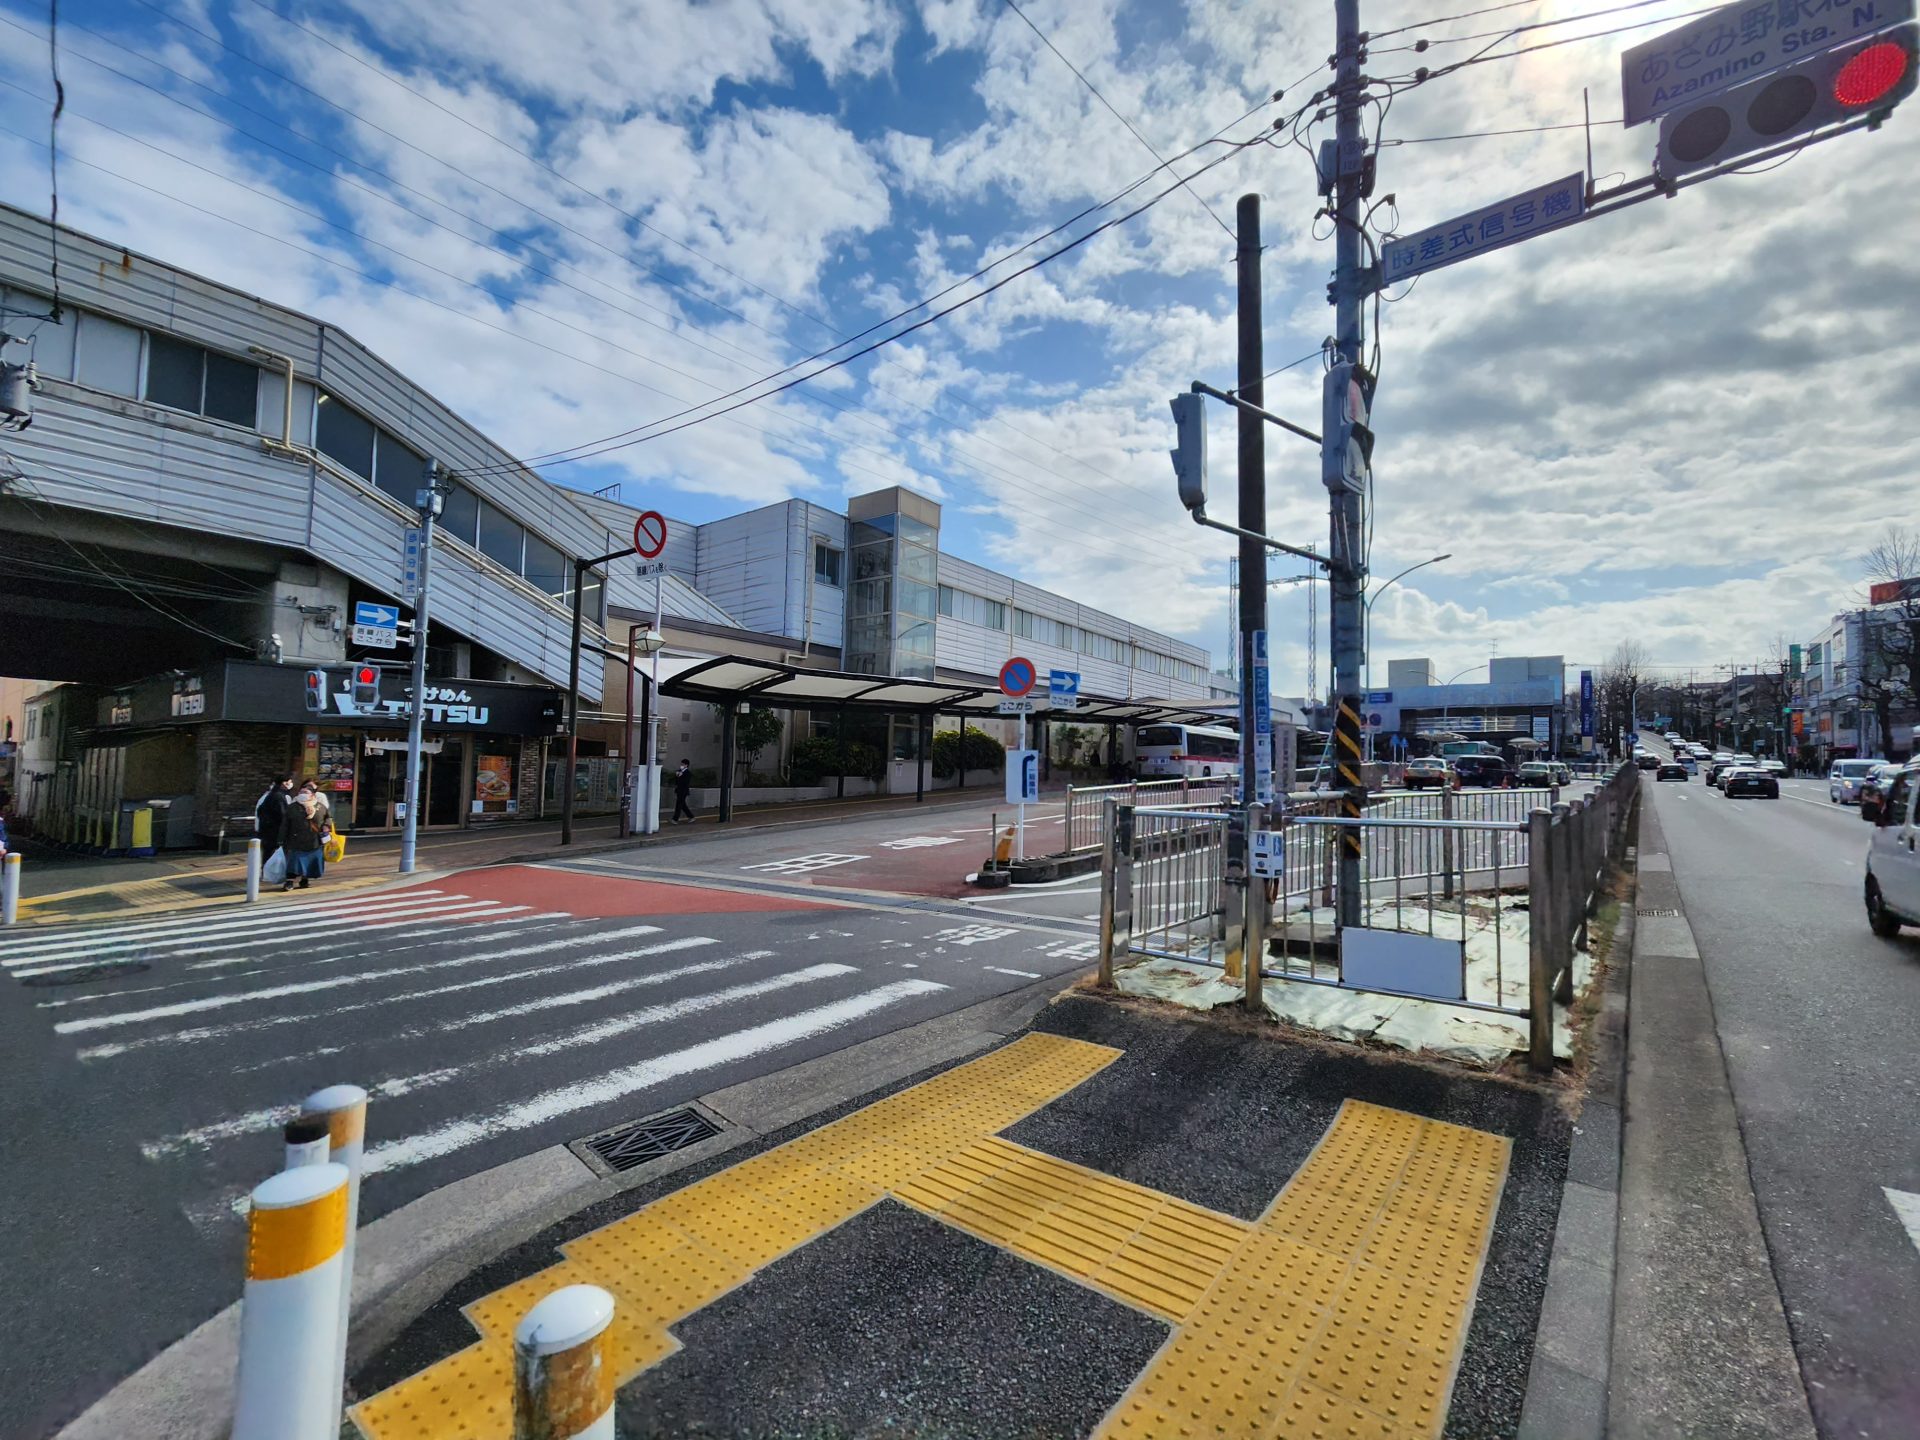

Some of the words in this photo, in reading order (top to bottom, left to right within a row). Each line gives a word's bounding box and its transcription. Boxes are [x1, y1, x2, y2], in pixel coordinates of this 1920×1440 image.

[1641, 0, 1850, 85] あざみ野駅
[1651, 50, 1765, 107] Azamino
[1782, 24, 1836, 54] Sta.
[1852, 2, 1883, 28] N.
[1392, 189, 1572, 270] 時差式信号機
[356, 636, 392, 646] ここから
[1000, 702, 1033, 711] ここから
[1051, 697, 1075, 707] ここから
[1257, 705, 1269, 732] END
